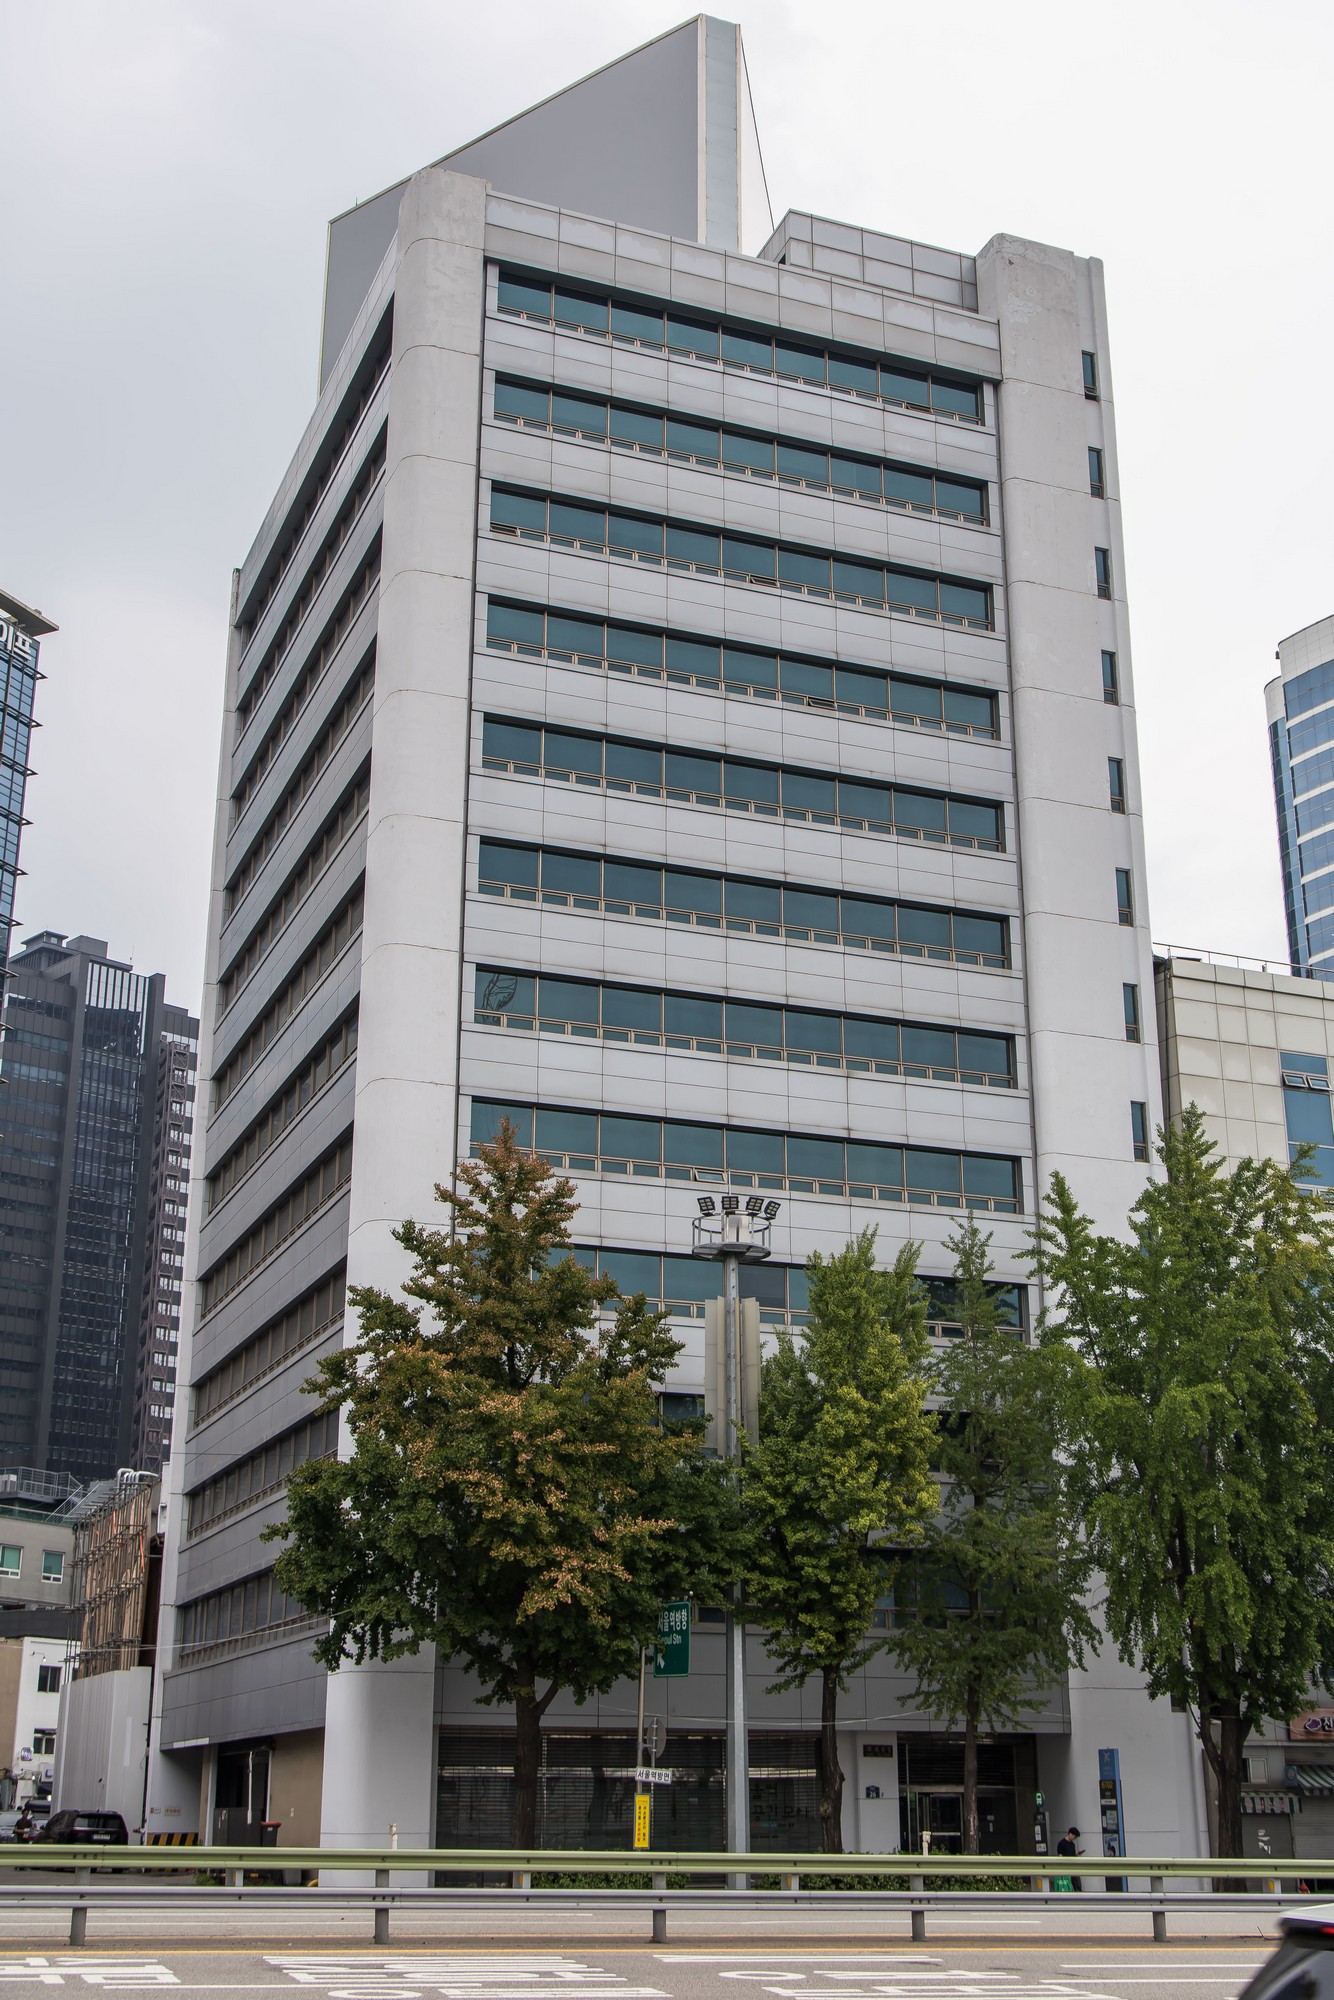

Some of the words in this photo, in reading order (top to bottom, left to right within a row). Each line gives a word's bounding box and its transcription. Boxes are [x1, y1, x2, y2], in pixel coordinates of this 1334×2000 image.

[657, 1608, 688, 1632] 서울역방향
[673, 1633, 682, 1645] Stn
[637, 1769, 671, 1782] 서울역방면
